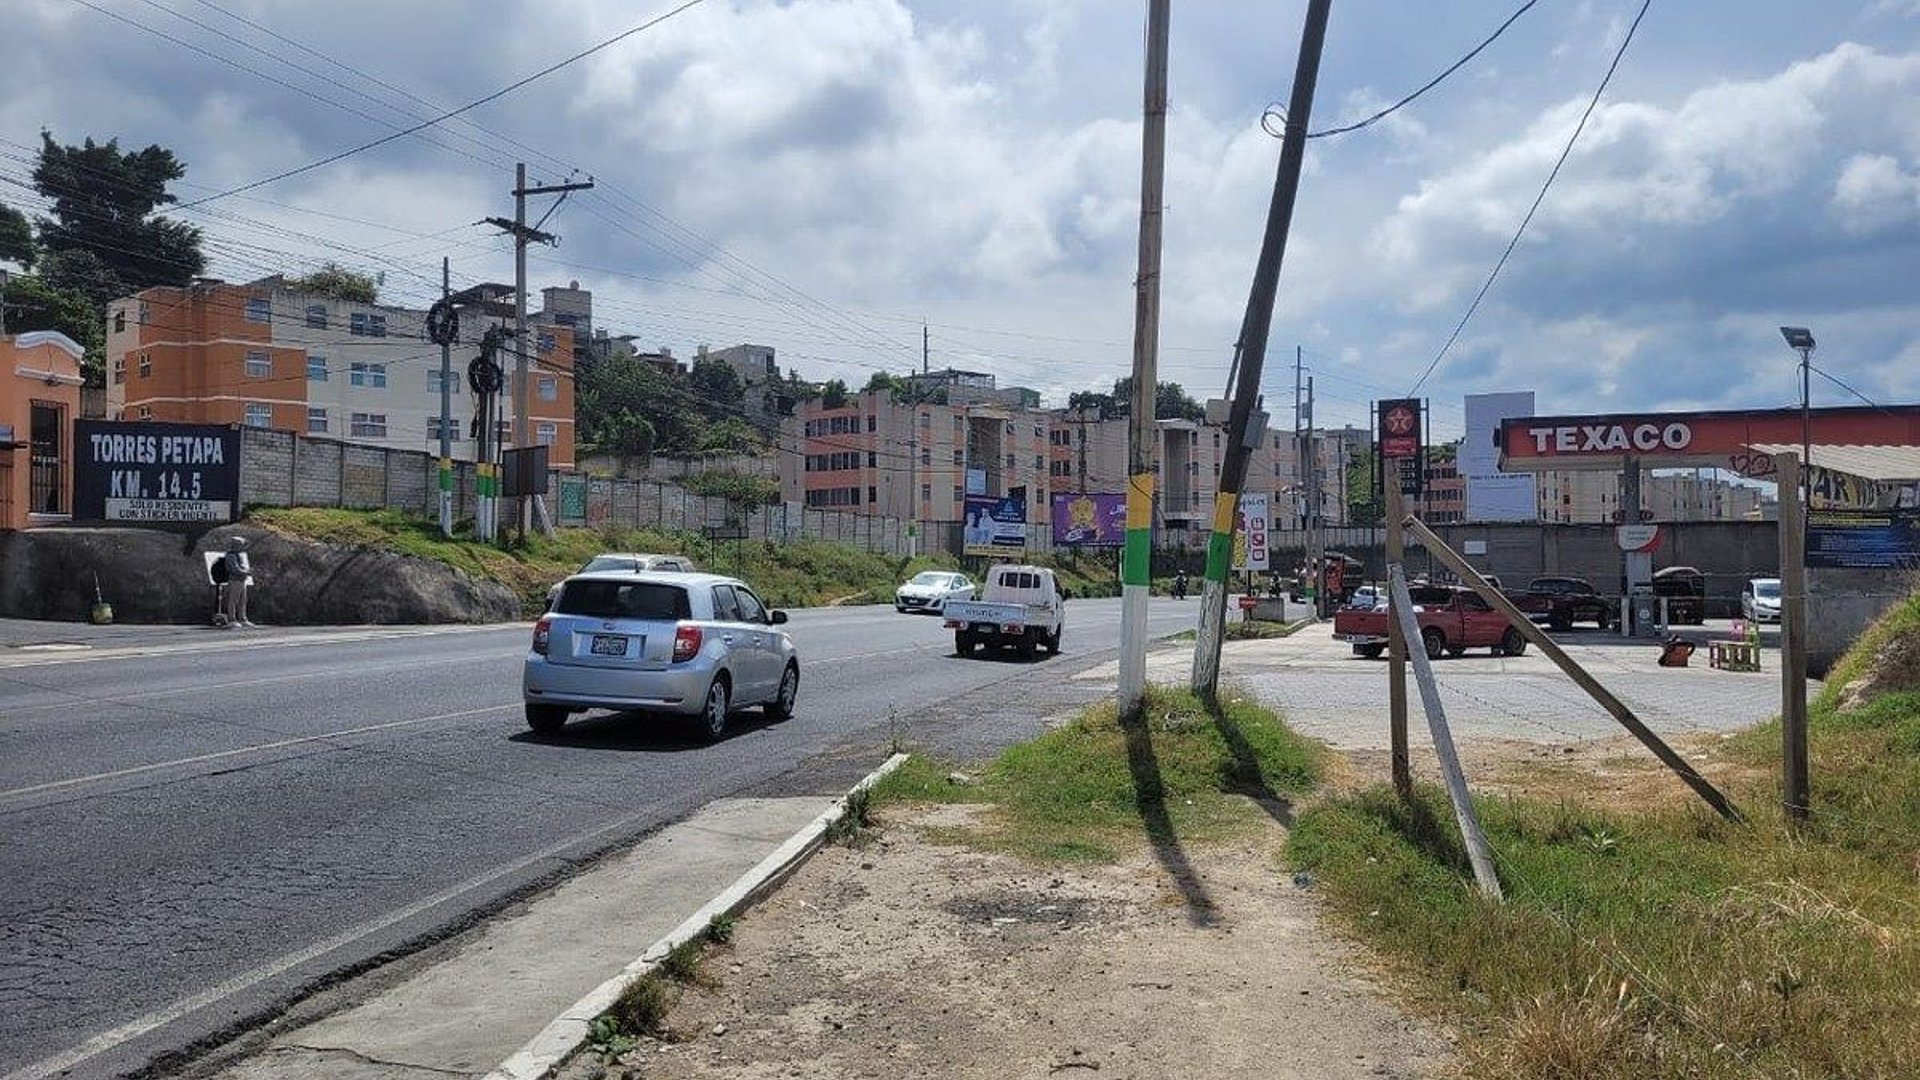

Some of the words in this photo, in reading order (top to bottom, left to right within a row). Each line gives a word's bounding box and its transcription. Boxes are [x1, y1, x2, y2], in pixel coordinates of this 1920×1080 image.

[91, 434, 157, 463] TORRES
[161, 436, 224, 464] PETAPA
[1530, 423, 1692, 452] TEXACO
[111, 470, 148, 497] KM.
[158, 471, 201, 499] 14.5
